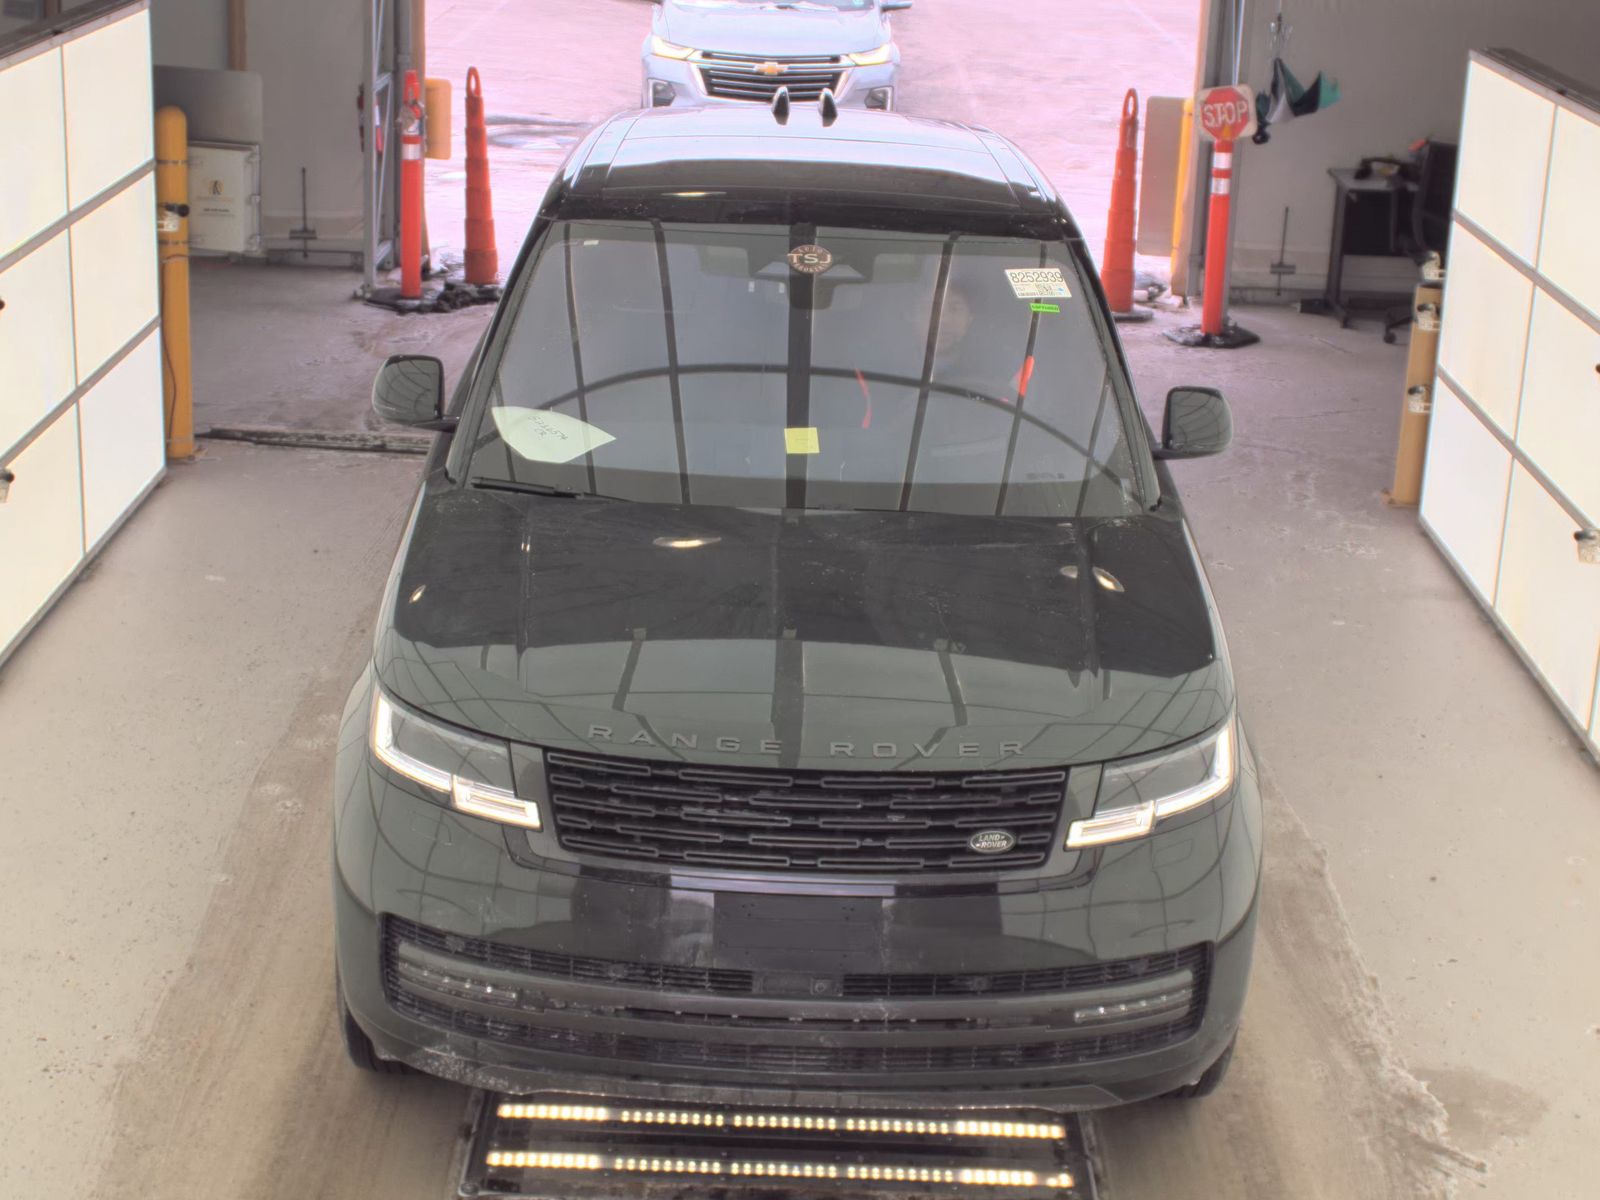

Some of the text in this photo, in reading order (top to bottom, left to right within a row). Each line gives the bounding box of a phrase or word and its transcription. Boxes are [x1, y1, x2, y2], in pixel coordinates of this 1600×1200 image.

[1203, 100, 1248, 128] STOP
[787, 253, 831, 264] TSJ
[1010, 271, 1064, 283] 8252939
[587, 724, 1024, 758] RANGE ROVER
[979, 833, 1001, 842] LAND
[980, 840, 1008, 849] ROVER
